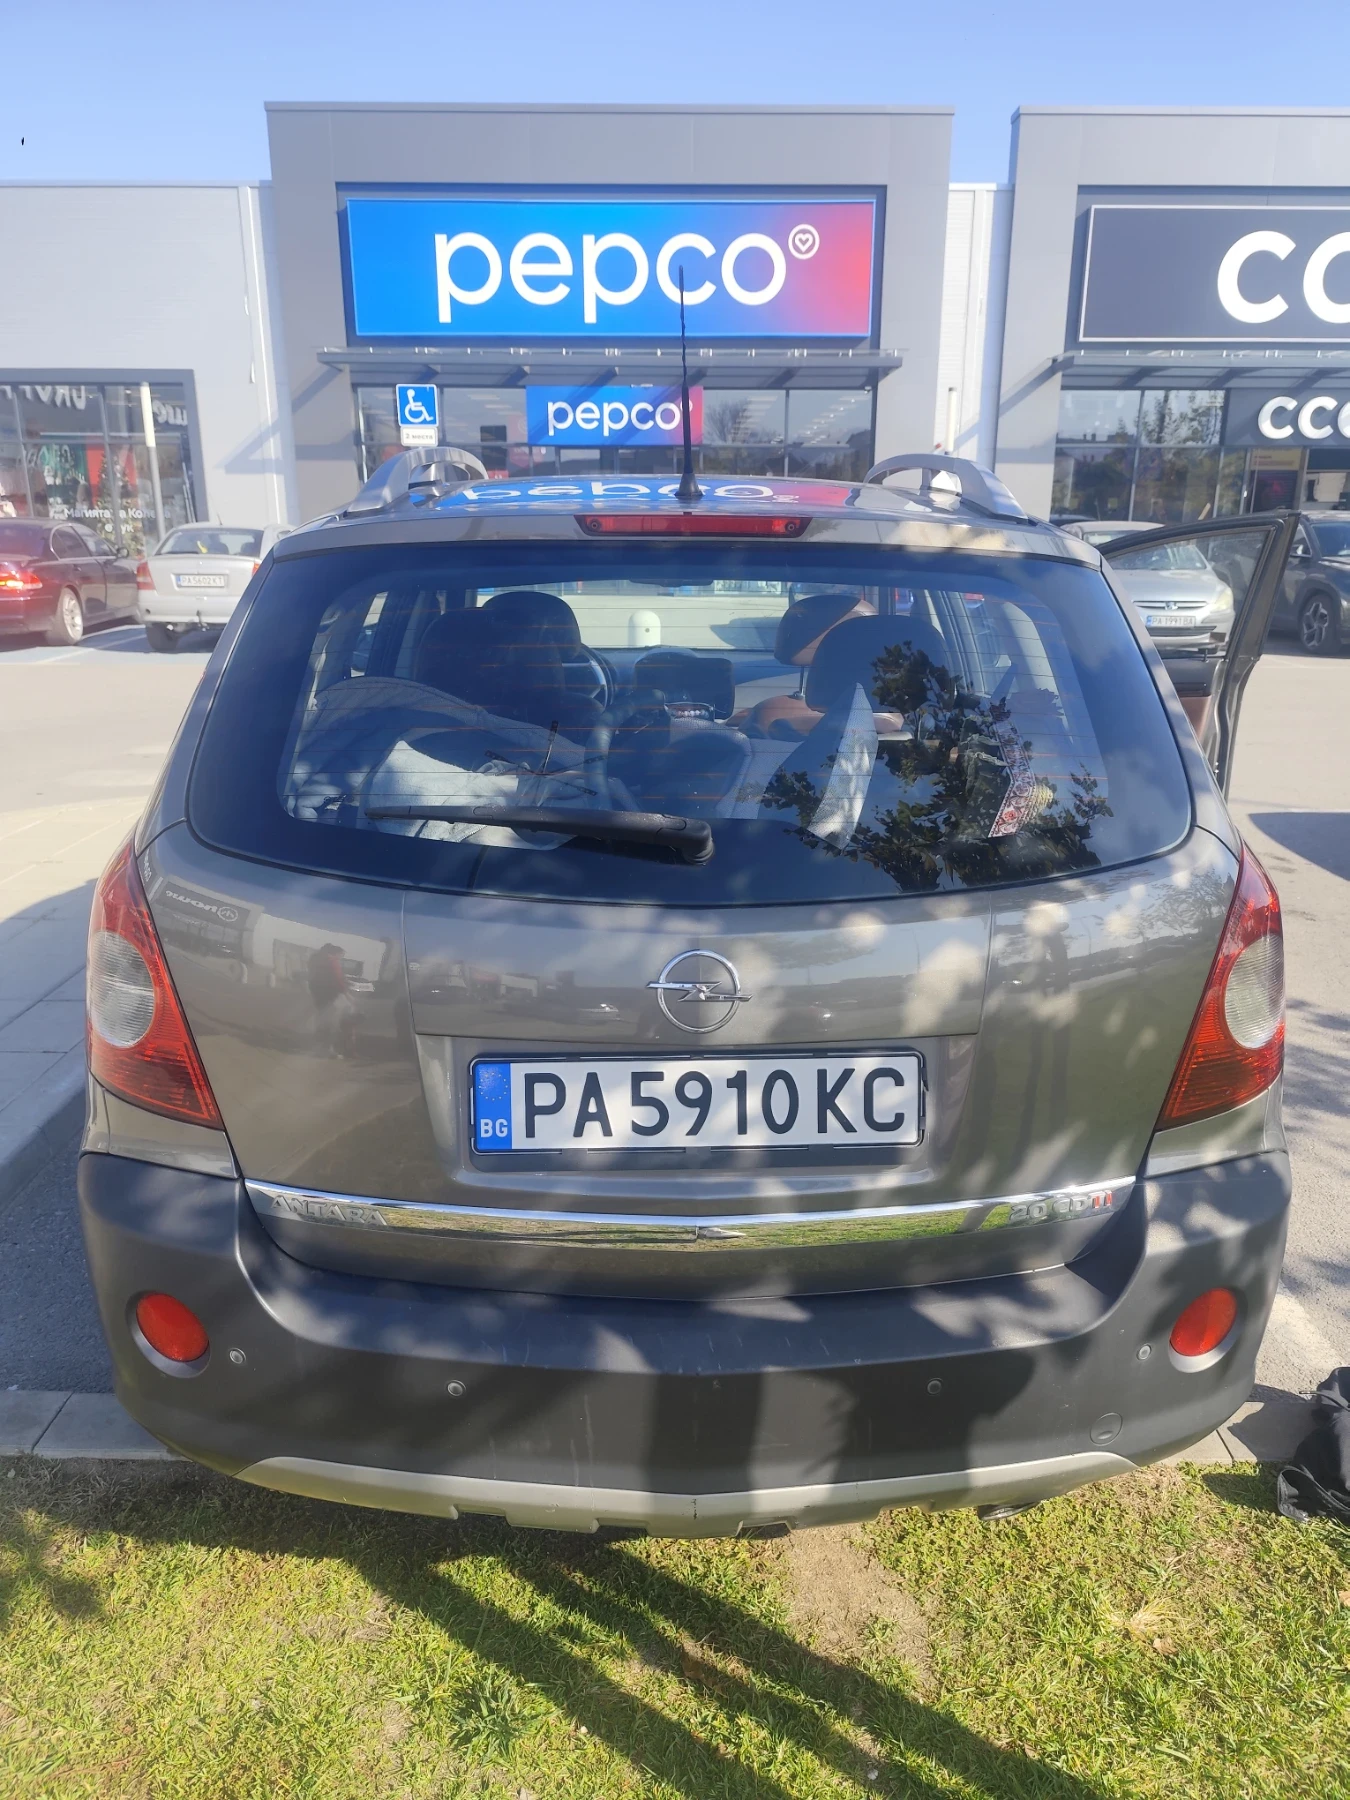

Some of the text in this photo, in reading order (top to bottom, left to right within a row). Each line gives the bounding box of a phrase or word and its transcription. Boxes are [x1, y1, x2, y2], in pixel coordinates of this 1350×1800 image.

[434, 232, 787, 324] pepco
[548, 401, 681, 437] pepco
[524, 1068, 905, 1139] PA 5910 KC
[480, 1118, 508, 1138] BG
[271, 1195, 388, 1226] ANTARA
